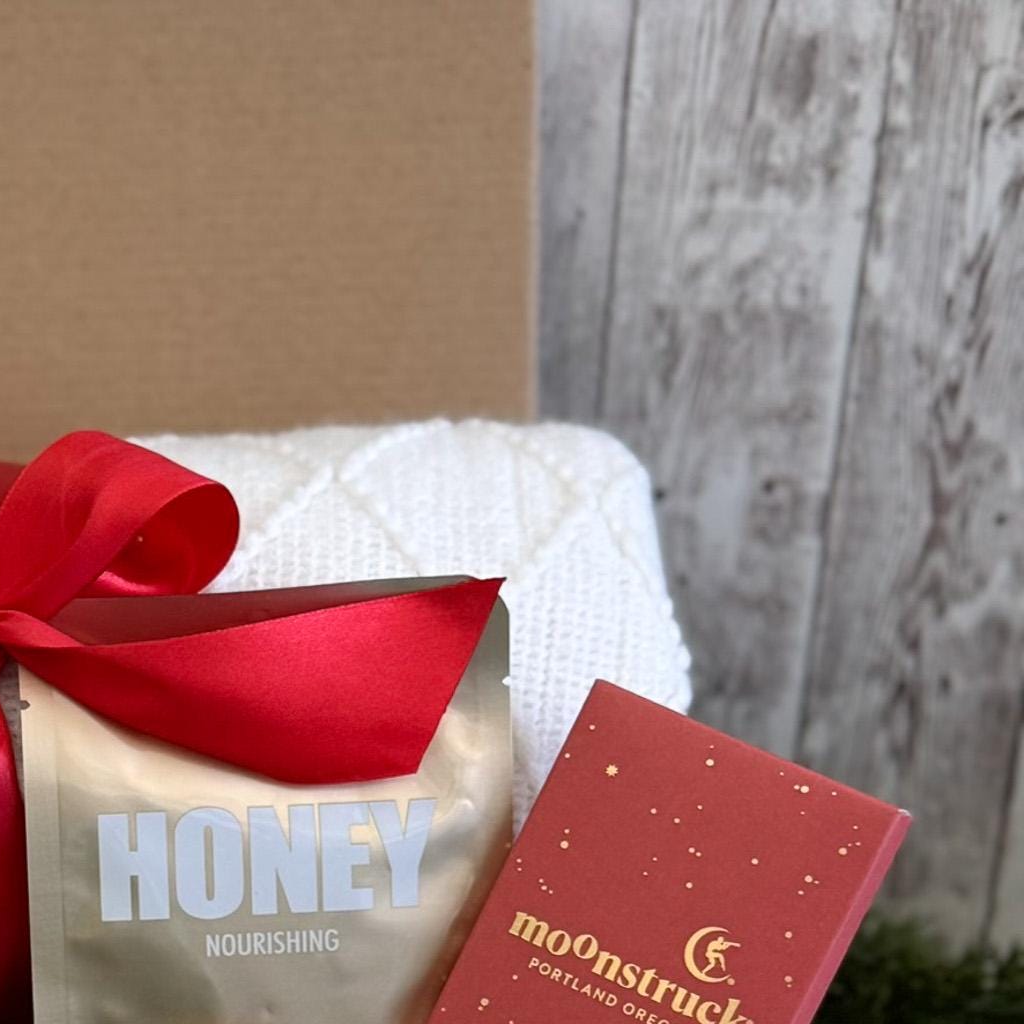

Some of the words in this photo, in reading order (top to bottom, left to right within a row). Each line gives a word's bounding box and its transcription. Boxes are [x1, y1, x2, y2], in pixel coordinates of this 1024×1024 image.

[97, 797, 438, 922] HONEY
[205, 929, 340, 957] NOURISHING
[528, 957, 618, 1008] PORTLAND
